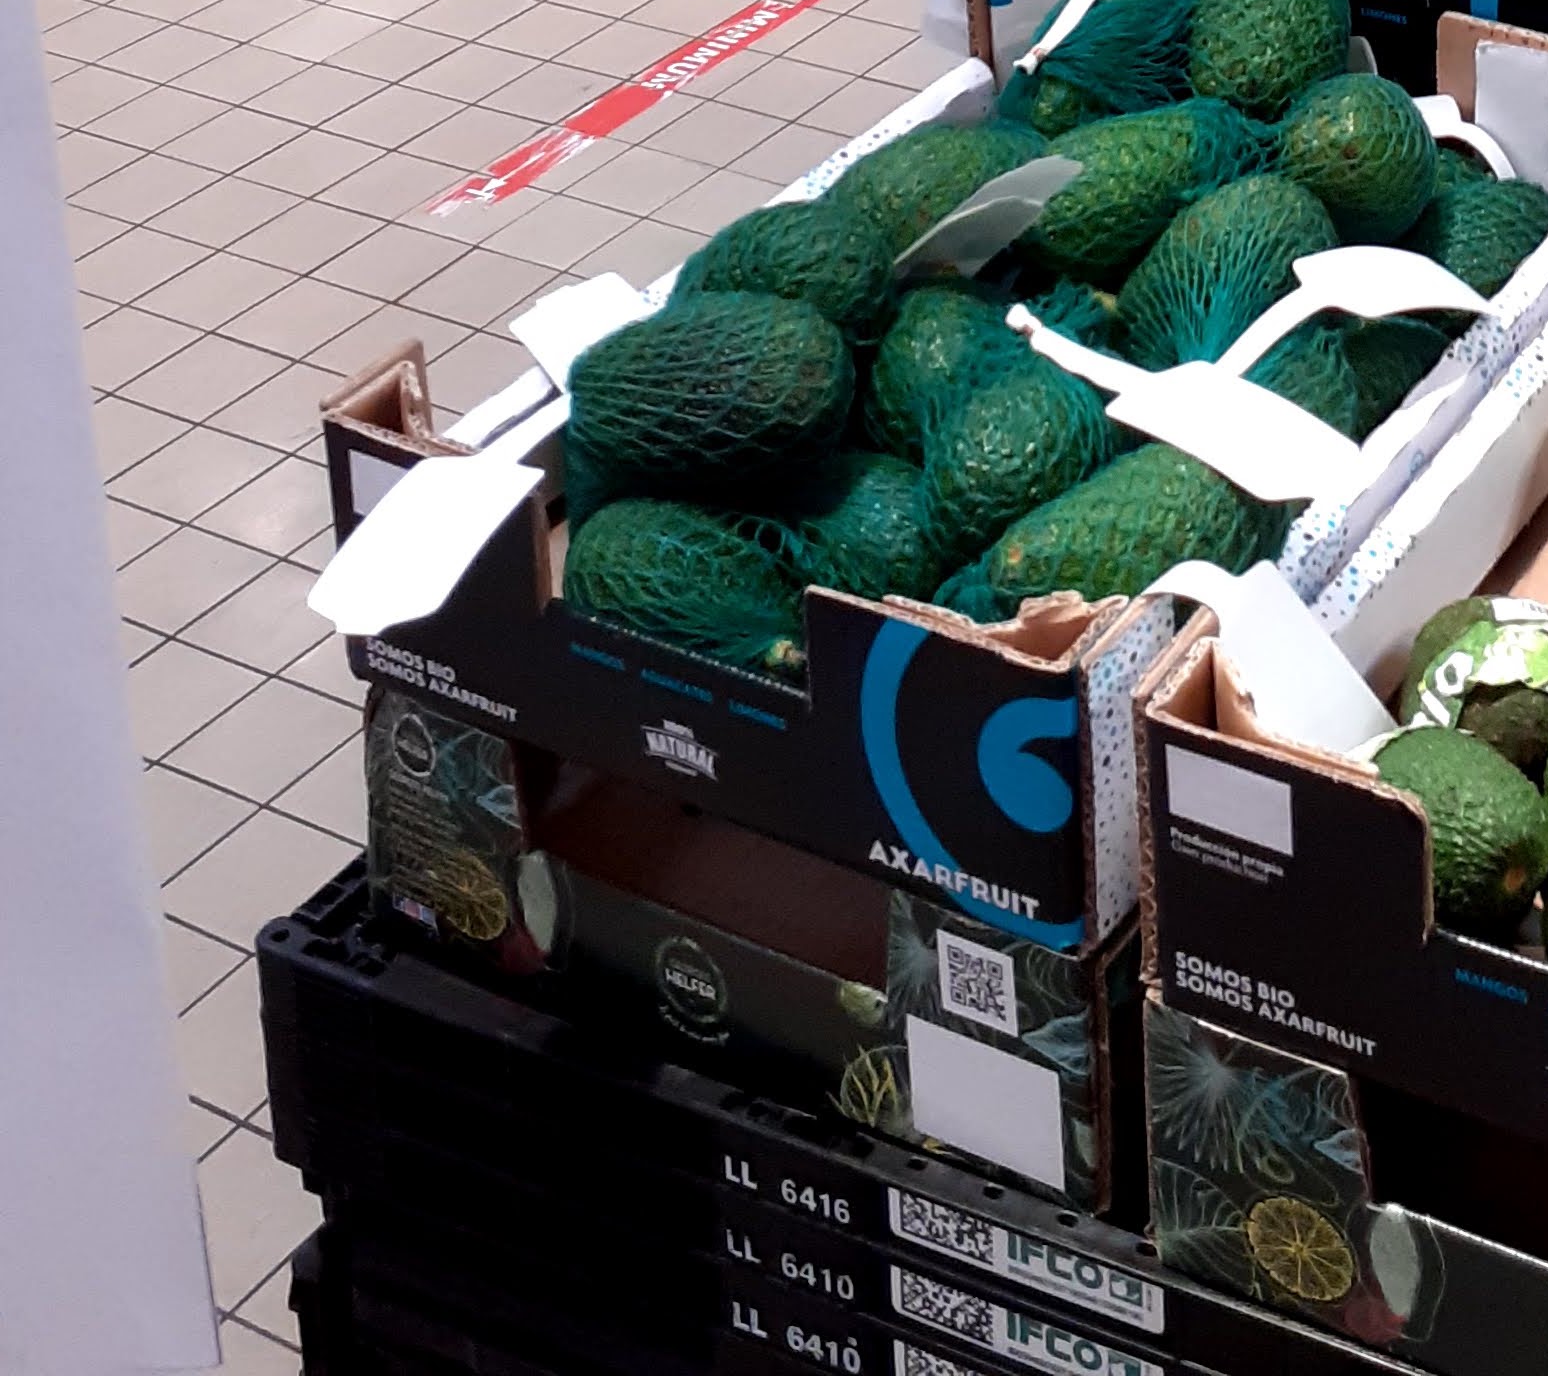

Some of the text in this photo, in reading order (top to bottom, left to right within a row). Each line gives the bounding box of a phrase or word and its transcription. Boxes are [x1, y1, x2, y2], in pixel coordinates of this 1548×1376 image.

[368, 653, 518, 723] SOMOS AXARFRUIT
[426, 660, 456, 683] BIO
[645, 729, 716, 780] NATURAL
[868, 840, 1041, 922] AXARFRUIT
[1175, 950, 1296, 1008] SOMOS BIO
[1176, 970, 1377, 1058] SOMOS AXARFRUIT
[725, 1154, 850, 1224] LL 6416
[726, 1228, 854, 1300] LL 6410
[1007, 1233, 1103, 1290] IFCO
[732, 1301, 861, 1374] LL 6410
[1006, 1309, 1103, 1371] IFCO
